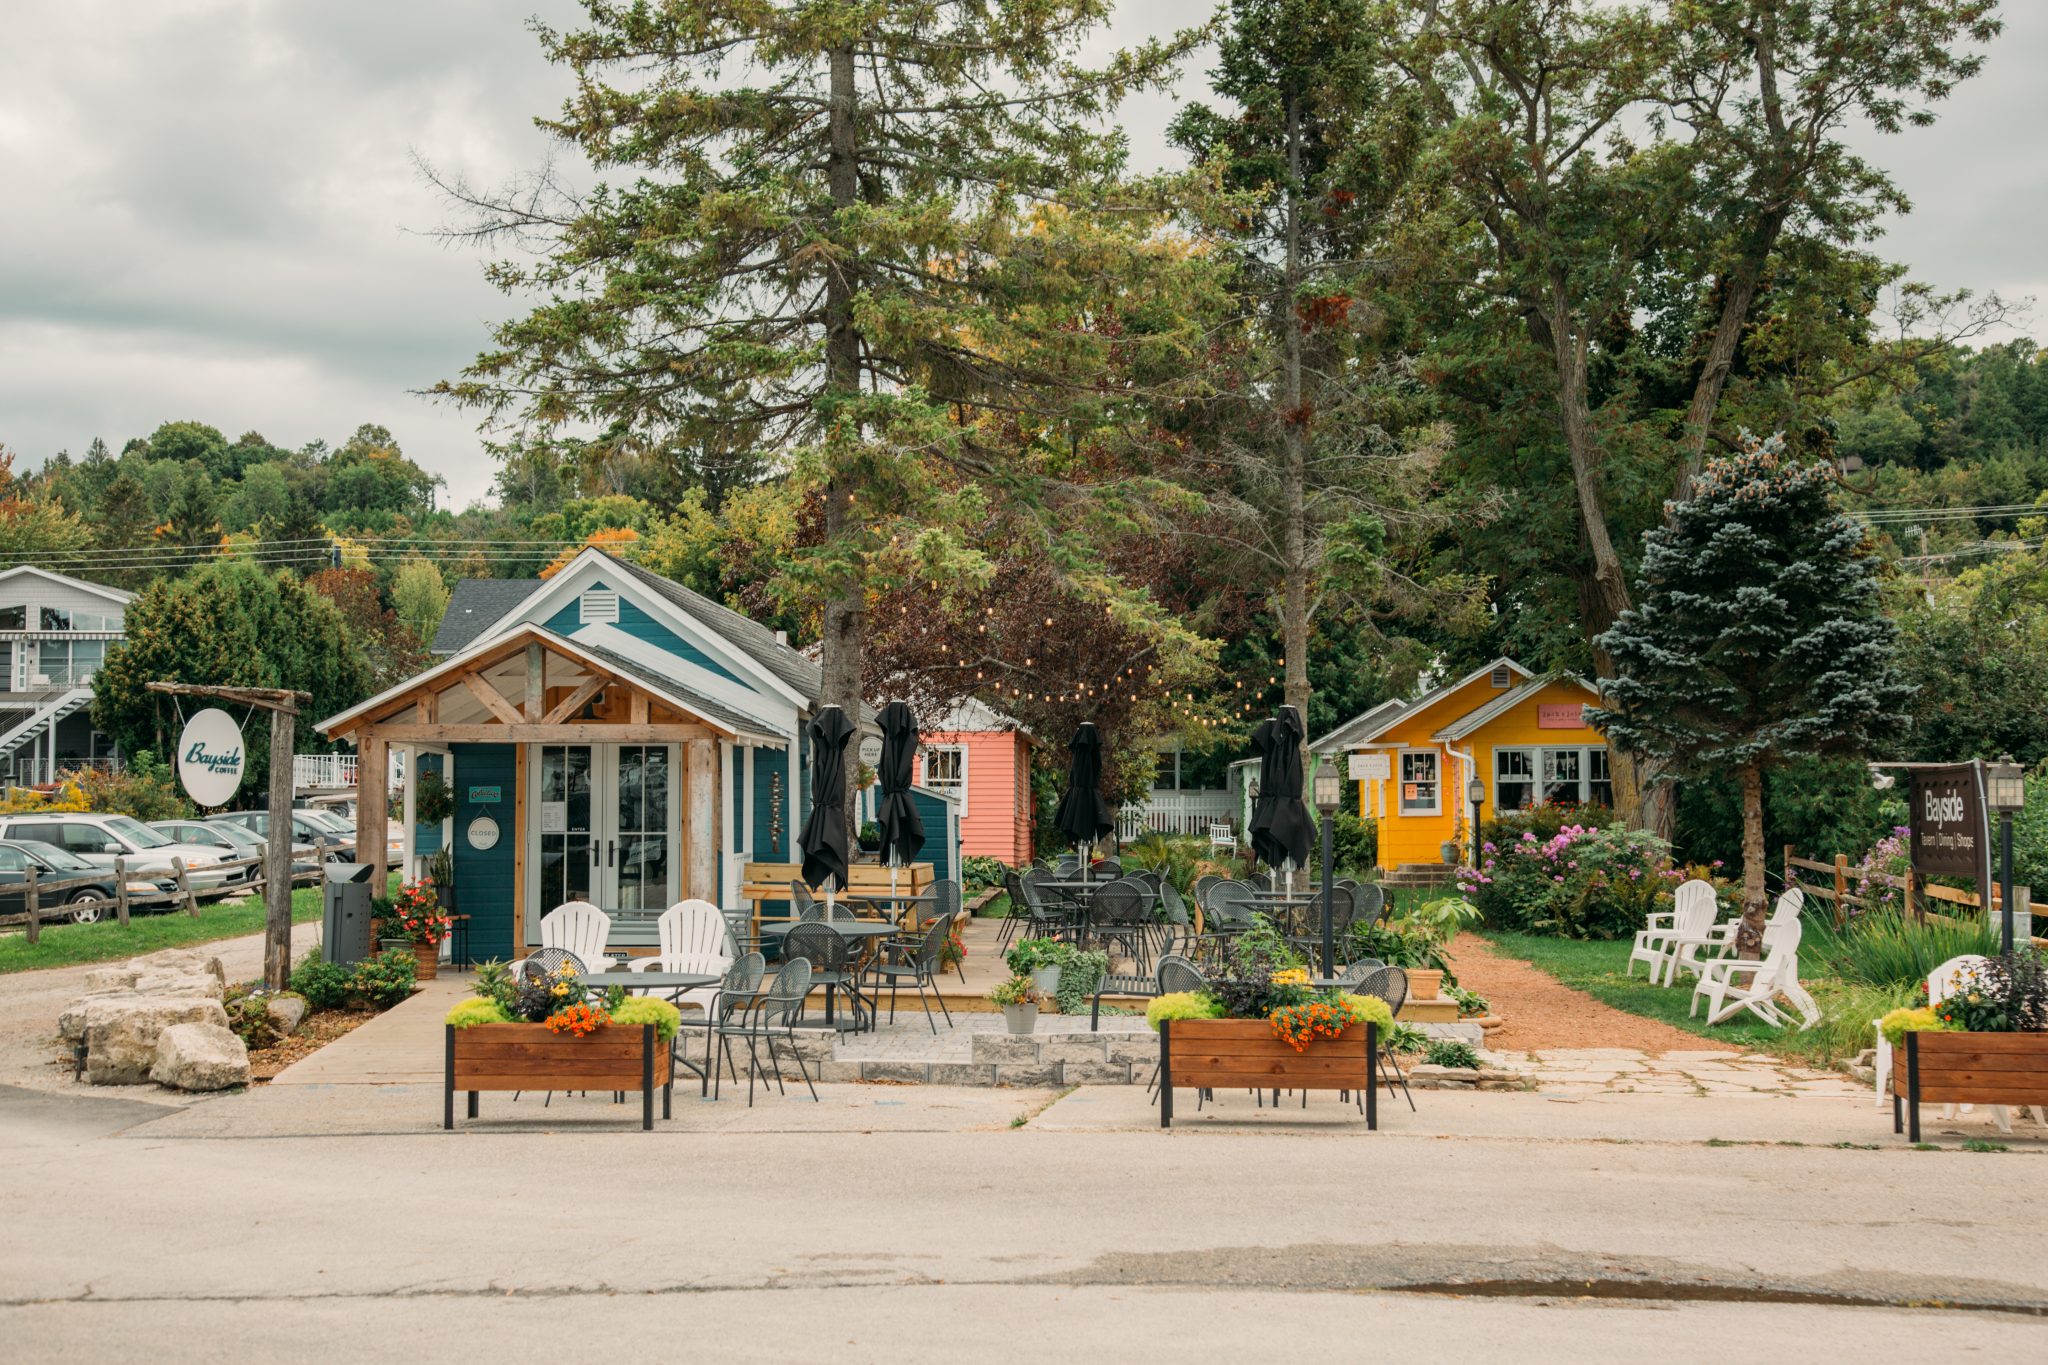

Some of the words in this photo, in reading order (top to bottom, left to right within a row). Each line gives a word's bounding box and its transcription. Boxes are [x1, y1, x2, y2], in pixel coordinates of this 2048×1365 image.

[185, 742, 240, 772] Bayside
[215, 767, 237, 775] COFFEE
[1925, 789, 1963, 829] Bayside
[1920, 832, 1936, 846] Tavern
[1938, 833, 1954, 850] Dining
[1957, 833, 1974, 850] Shops
